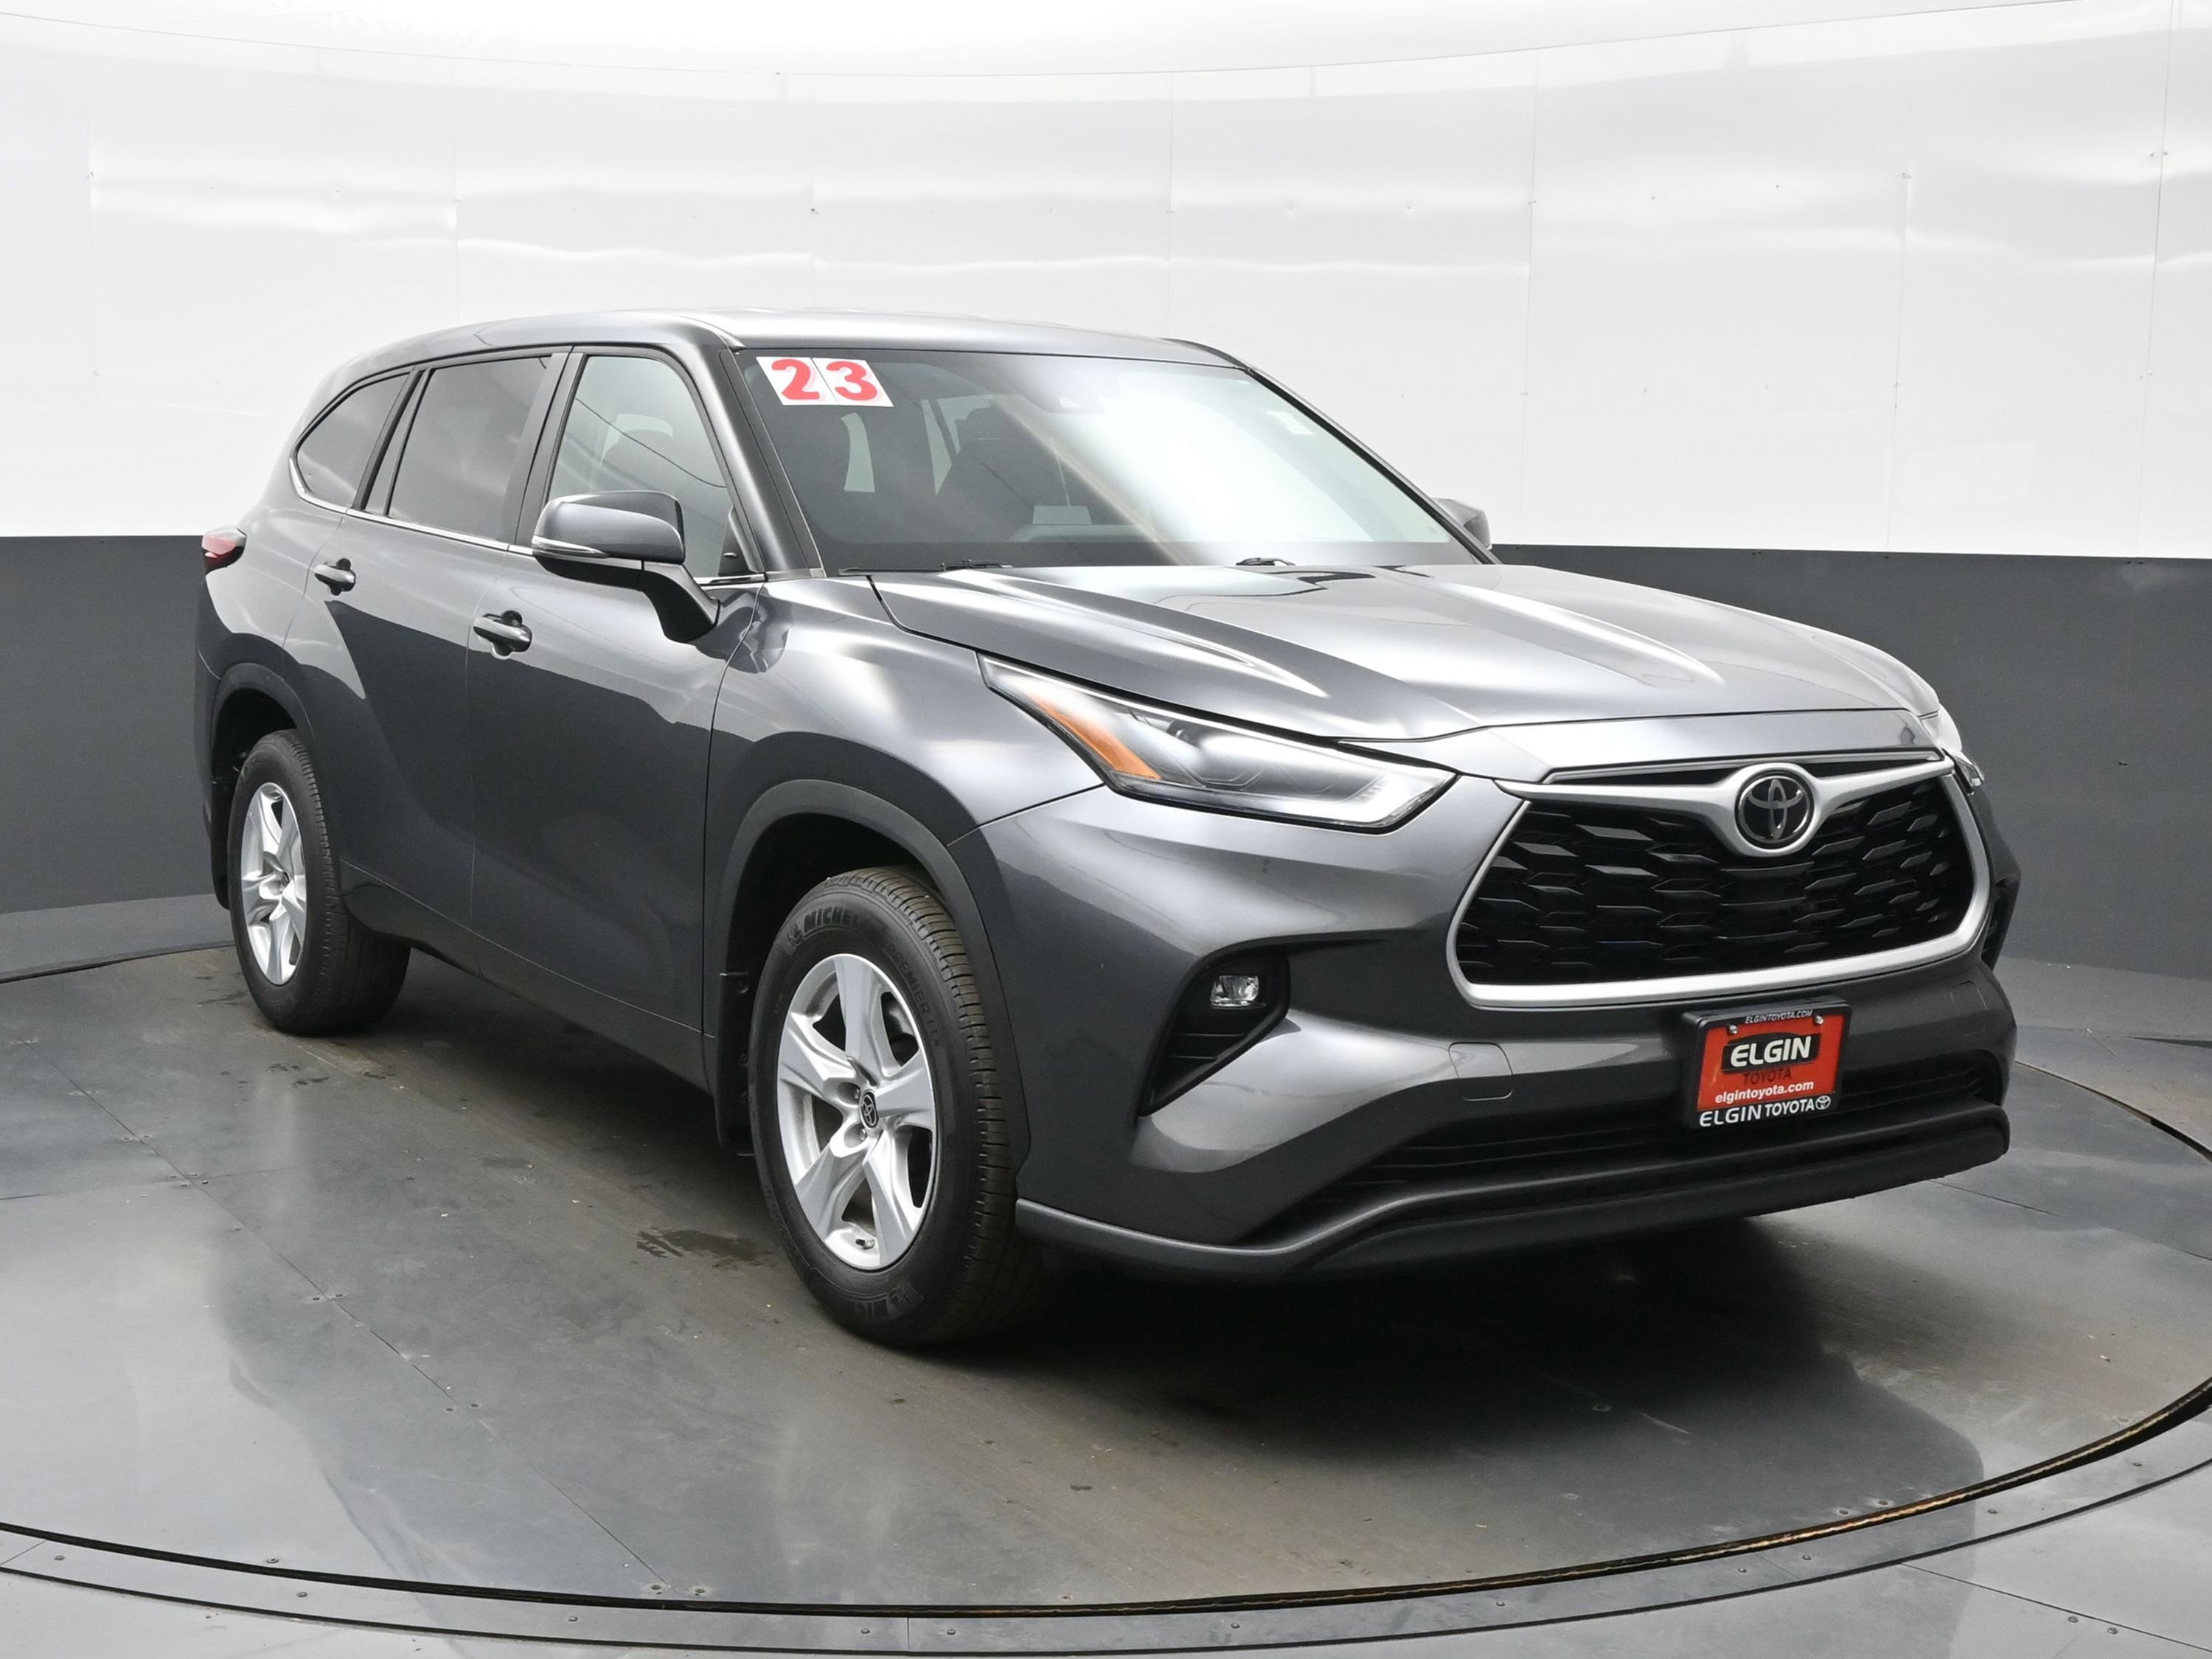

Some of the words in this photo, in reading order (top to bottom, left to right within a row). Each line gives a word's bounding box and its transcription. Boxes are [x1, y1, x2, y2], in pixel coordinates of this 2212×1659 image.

[771, 358, 877, 400] 23
[804, 905, 863, 933] MICHEL
[1745, 1010, 1813, 1024] ELGINTOYOTA.COM
[1731, 1036, 1812, 1068] ELGIN
[1742, 1068, 1792, 1085] TOYOTA
[1715, 1082, 1815, 1104] elgintoyota.com
[1700, 1105, 1761, 1127] ELGIN
[1764, 1098, 1815, 1116] TOYOTA
